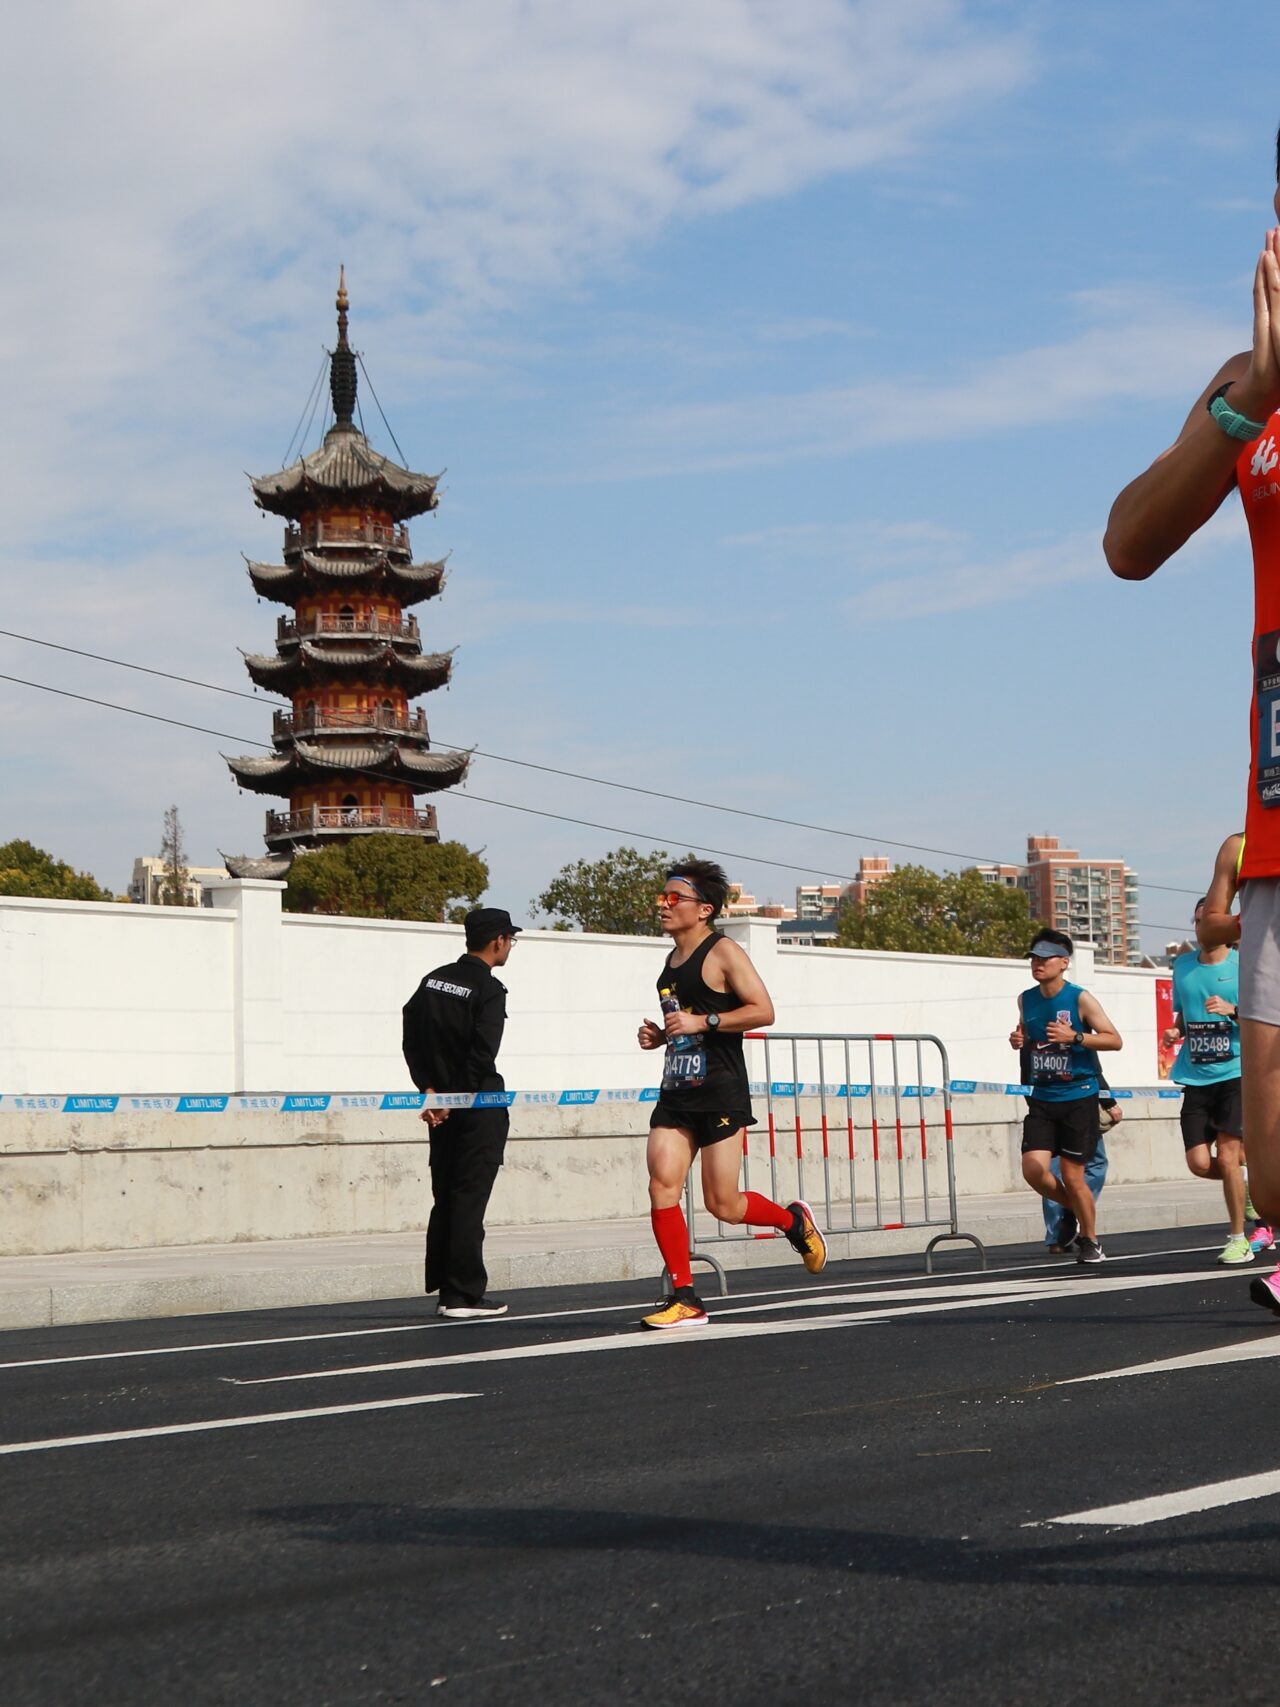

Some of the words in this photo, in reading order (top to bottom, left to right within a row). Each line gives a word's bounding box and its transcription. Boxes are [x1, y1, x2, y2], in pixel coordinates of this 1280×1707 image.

[441, 982, 472, 999] SECURITY
[1190, 1036, 1230, 1052] D25489
[1033, 1056, 1068, 1070] B14007
[388, 1096, 422, 1107] LIMITLINE
[480, 1094, 512, 1105] LIMITLINE
[565, 1091, 595, 1102] LIMITLINE
[72, 1098, 113, 1110] LIMITLINE
[186, 1098, 224, 1109] LIMITLINE
[290, 1097, 326, 1108] LIMITLINE
